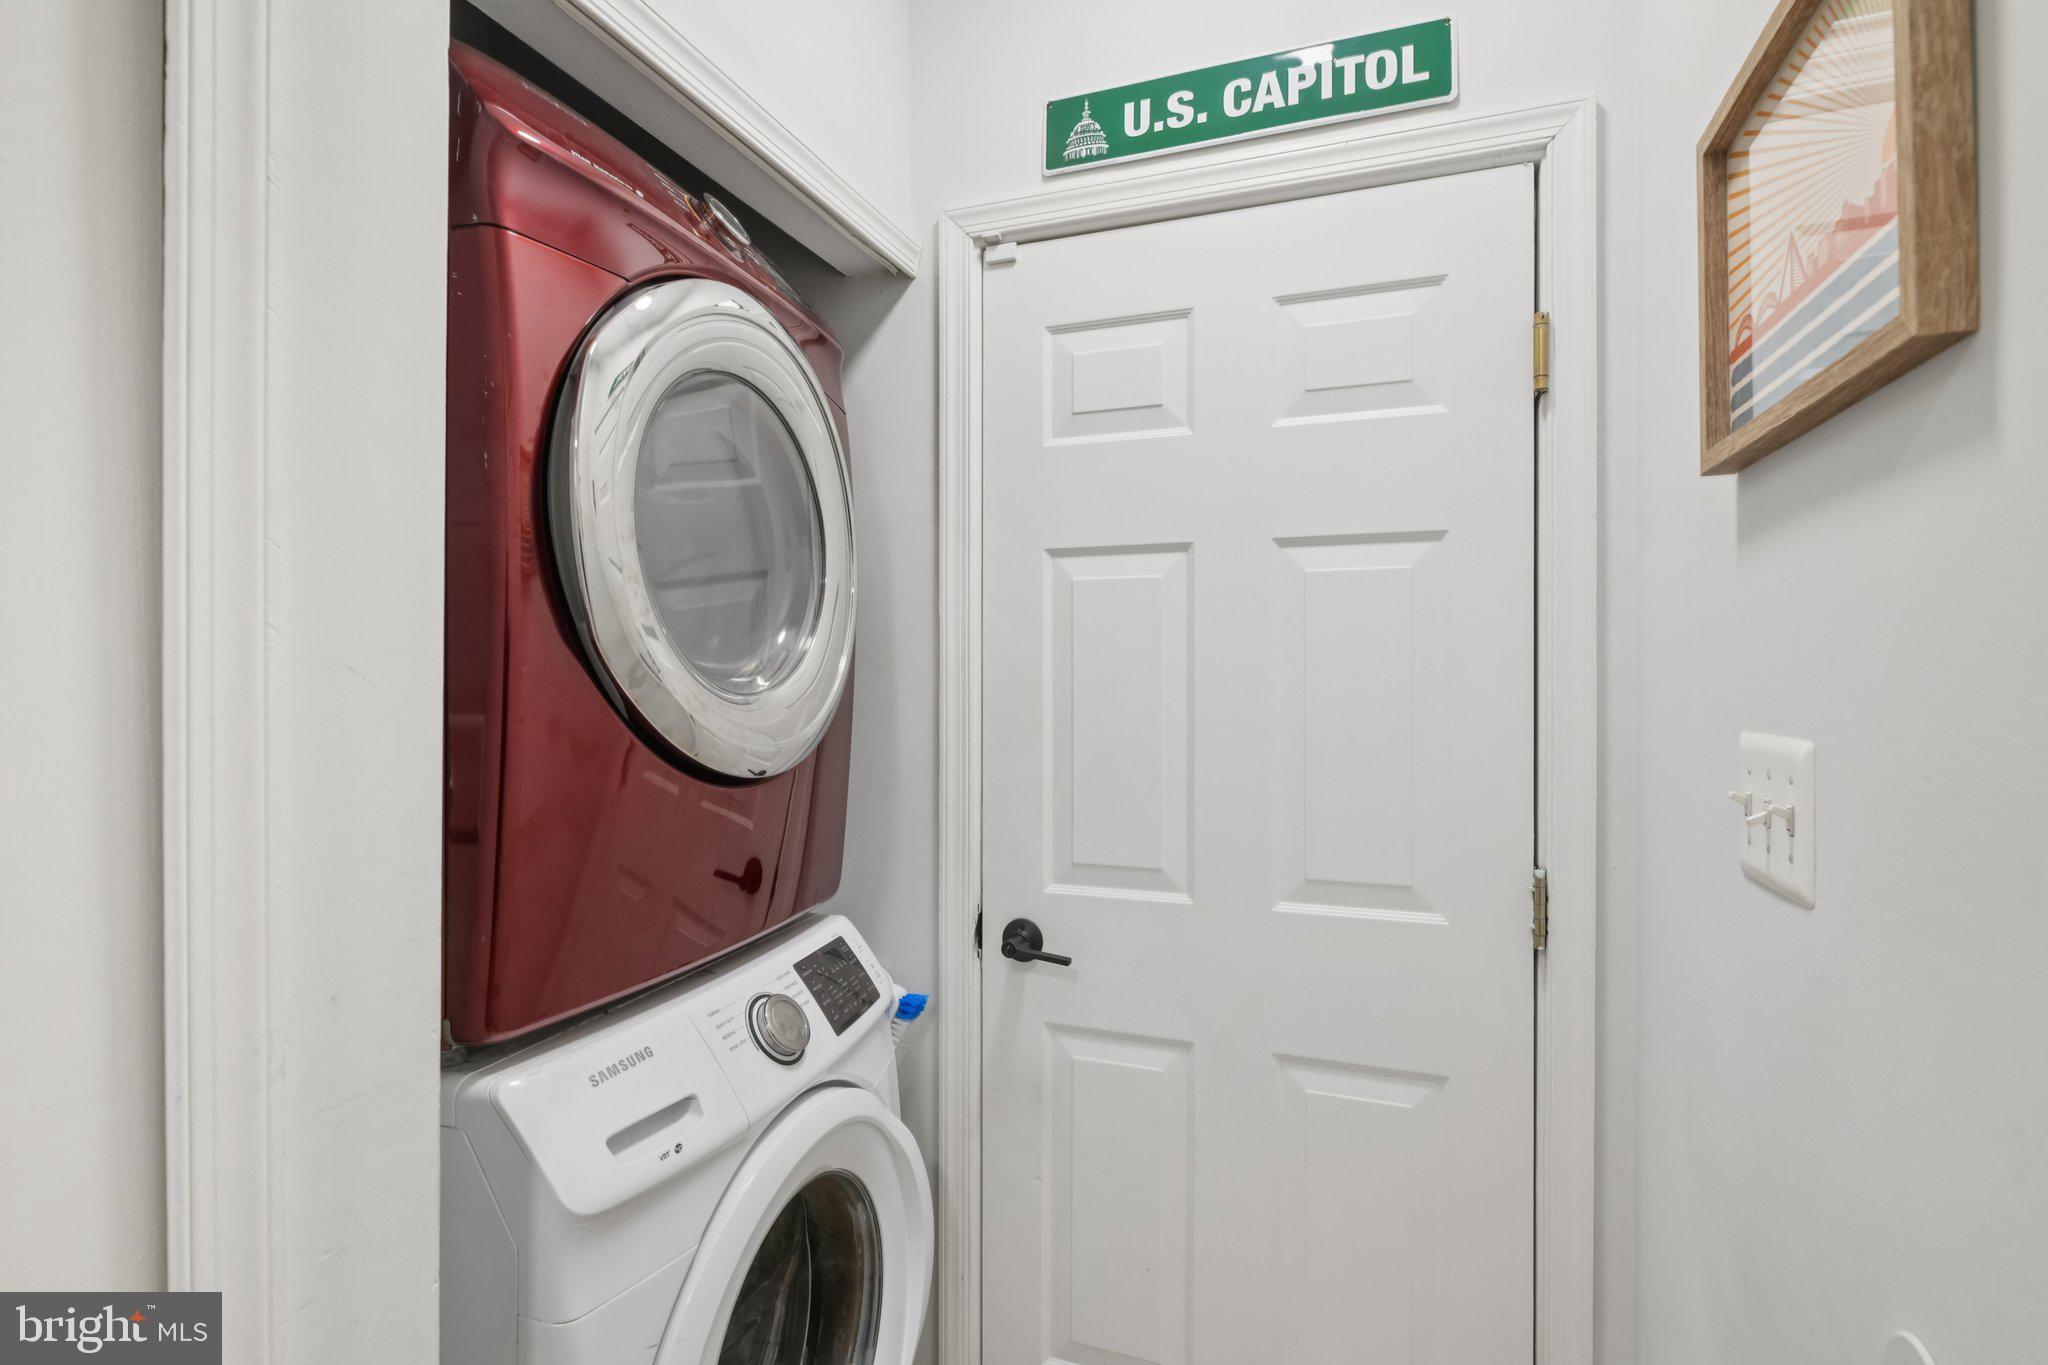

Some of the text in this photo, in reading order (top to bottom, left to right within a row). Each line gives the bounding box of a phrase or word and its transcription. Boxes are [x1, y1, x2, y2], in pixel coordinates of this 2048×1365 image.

[1123, 44, 1430, 138] U.S. CAPITOL
[588, 1046, 654, 1088] SAMSUNG
